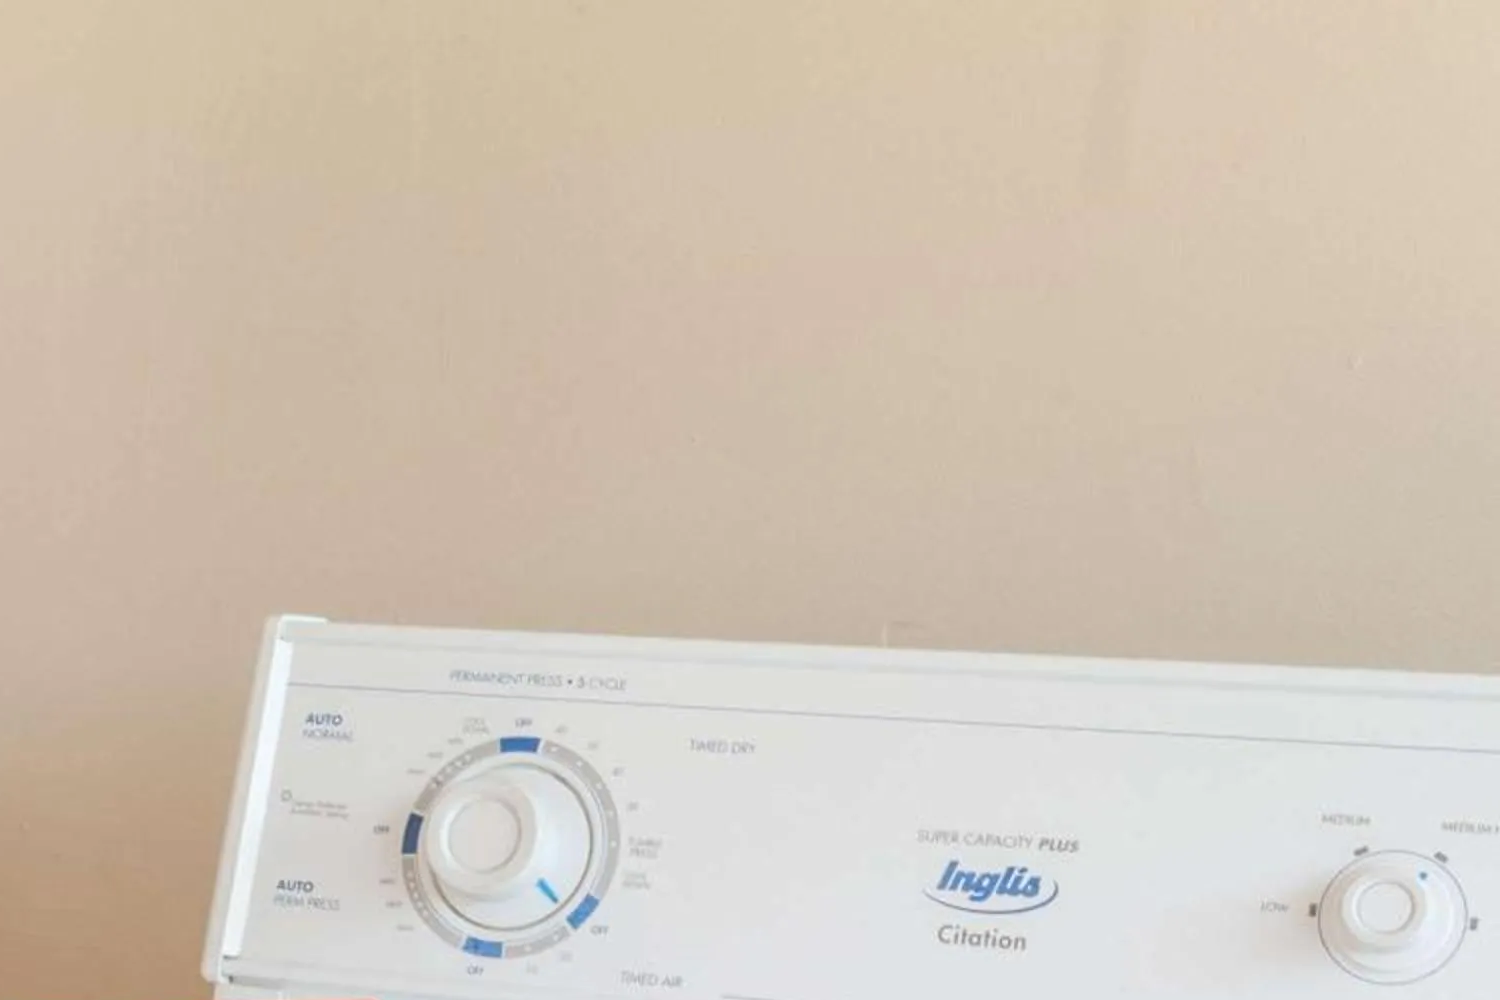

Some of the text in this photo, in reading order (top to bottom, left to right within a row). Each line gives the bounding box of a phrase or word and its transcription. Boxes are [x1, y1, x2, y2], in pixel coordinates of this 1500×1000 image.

[304, 712, 344, 727] AUTO
[916, 829, 1080, 853] SUPER CAPACITY PLUS
[276, 879, 315, 893] AUTO
[936, 860, 1042, 902] Inglis
[937, 924, 1028, 951] Citation
